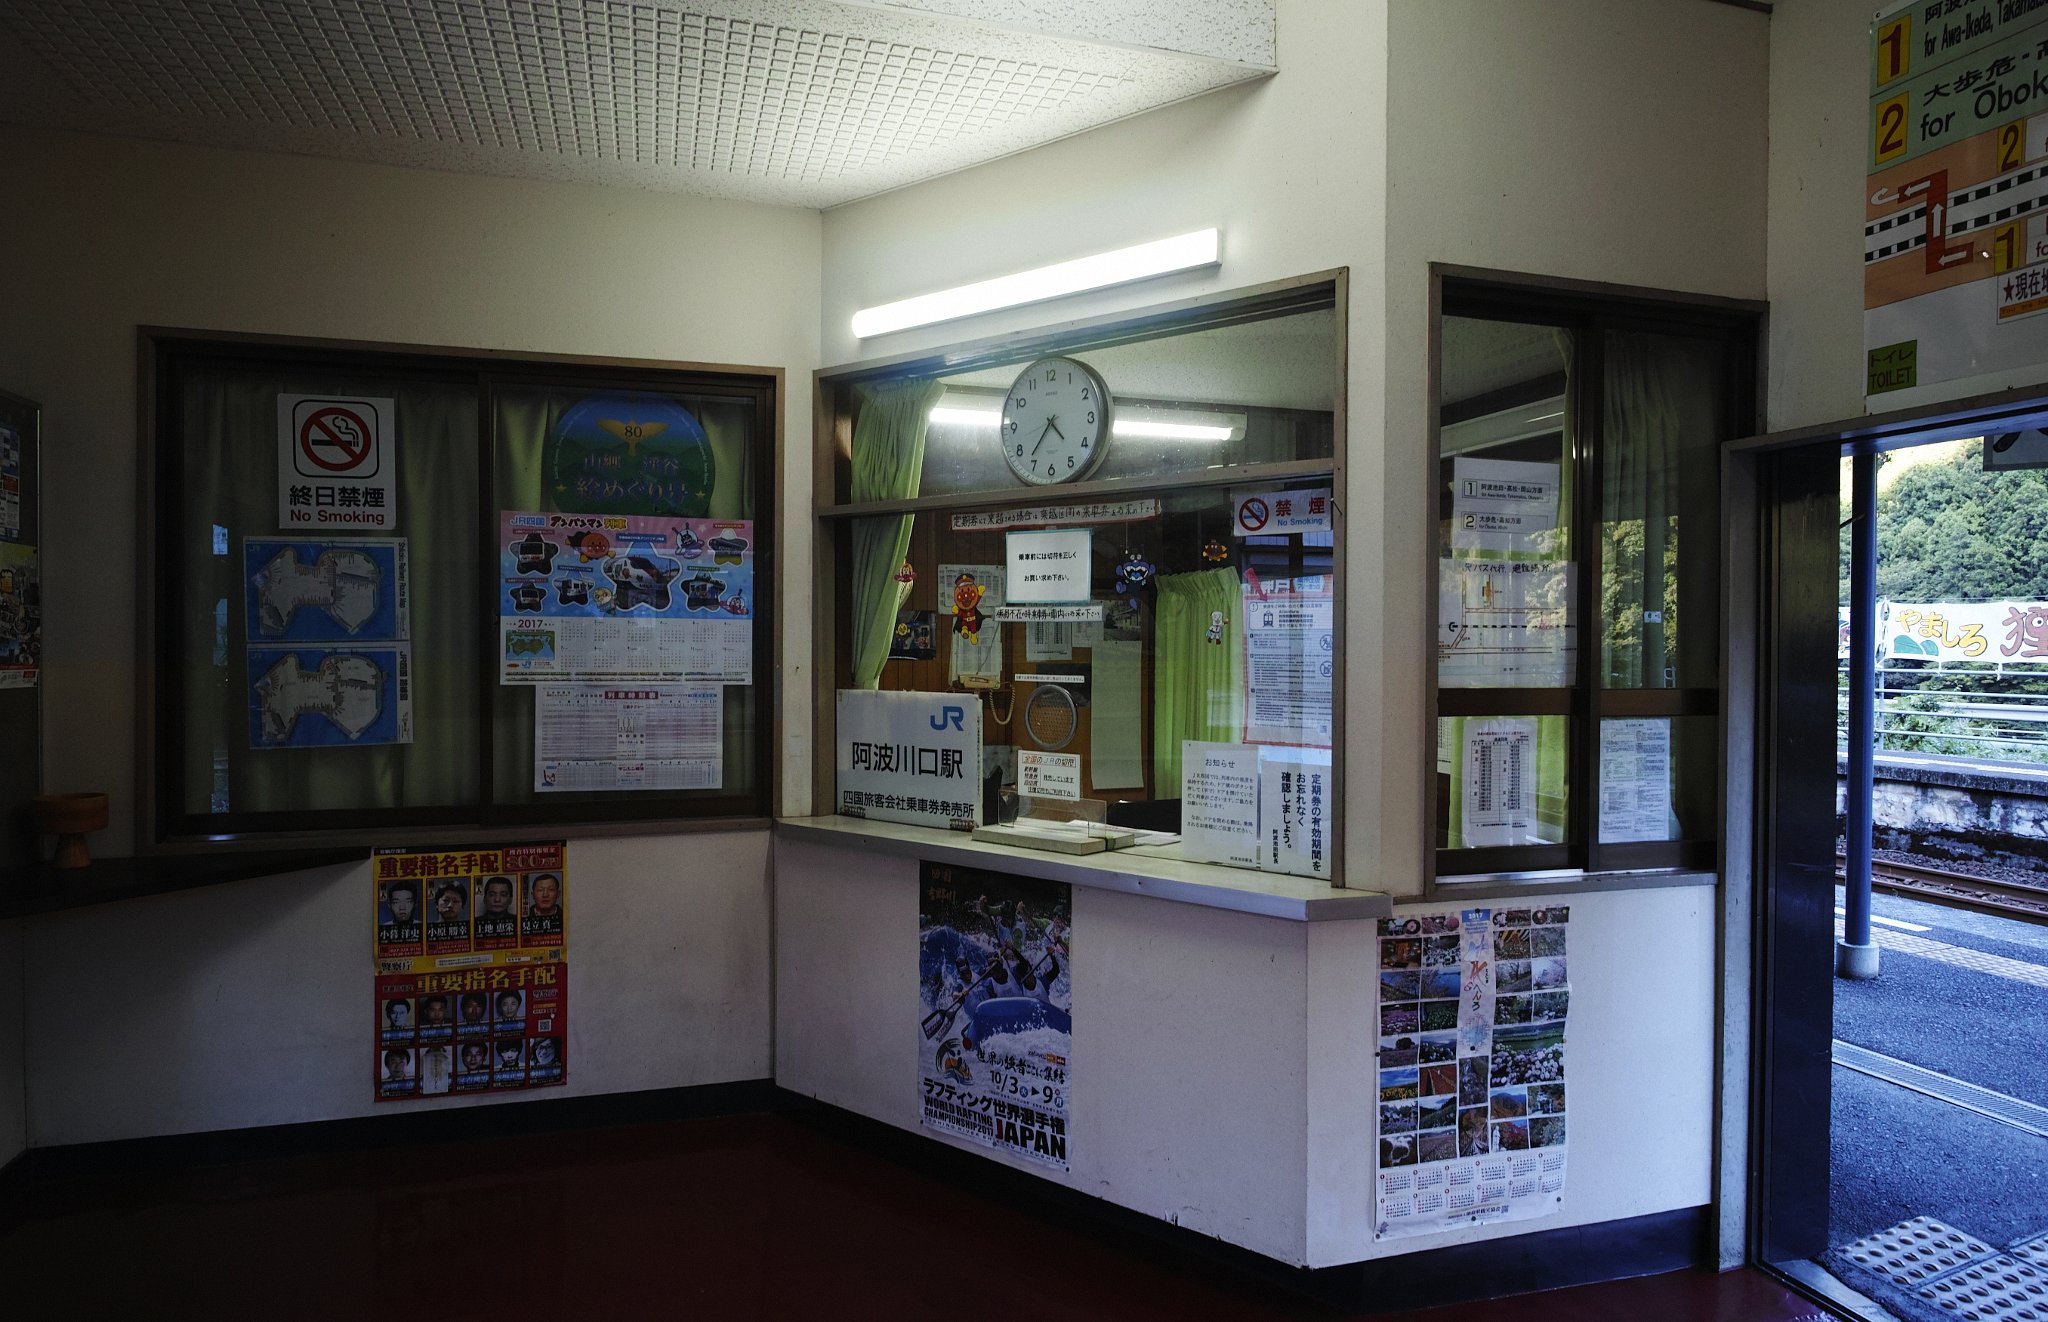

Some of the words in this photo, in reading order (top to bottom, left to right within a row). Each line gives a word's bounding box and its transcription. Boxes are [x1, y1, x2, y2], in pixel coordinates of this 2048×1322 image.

[1924, 32, 1936, 58] for
[1942, 6, 1994, 50] Awa-Ikeda,
[1881, 24, 1902, 77] 1
[1880, 103, 1904, 155] 2
[1920, 111, 1956, 141] for
[2001, 124, 2019, 172] 2
[1996, 226, 2015, 270] 1
[1871, 348, 1914, 367] トイレ
[1029, 379, 1037, 390] 11
[1046, 369, 1056, 383] 12
[1870, 367, 1913, 389] TOILET
[1016, 398, 1026, 410] 10
[1082, 388, 1089, 400] 2
[1010, 422, 1017, 434] 9
[1087, 411, 1095, 424] 3
[624, 426, 643, 437] 80
[1016, 444, 1023, 457] 8
[1081, 437, 1089, 448] 4
[1031, 460, 1038, 472] 7
[1048, 464, 1055, 476] 6
[1067, 456, 1074, 468] 5
[289, 485, 385, 508] 終日禁煙
[1467, 483, 1473, 495] 1
[1275, 496, 1326, 517] 禁煙
[290, 509, 312, 522] No
[318, 510, 385, 526] Smoking
[550, 516, 628, 530] アンパンマン列車
[1278, 519, 1288, 527] No
[1289, 517, 1323, 527] Smoking
[1466, 515, 1475, 528] 2
[518, 619, 544, 629] 2017
[1895, 608, 1988, 657] やましろ
[930, 705, 964, 732] JR
[851, 741, 965, 781] 阿波川口駅
[1204, 758, 1236, 770] お知らせ
[843, 790, 975, 819] 四国旅客会社乗車券発売所
[1280, 771, 1292, 853] 確認しましょう。
[1295, 775, 1307, 828] お忘れなく
[1311, 774, 1322, 873] 定期券の有効期間を
[1272, 829, 1280, 865] 阿波池田駅長
[378, 852, 500, 879] 重要指名手配
[416, 966, 557, 993] 重要指名手配
[1043, 1086, 1053, 1104] 9
[924, 1077, 1066, 1138] ラフティング世界選手権
[924, 1096, 955, 1114] WORLD
[956, 1105, 993, 1128] RAFTING
[996, 1118, 1066, 1161] JAPAN
